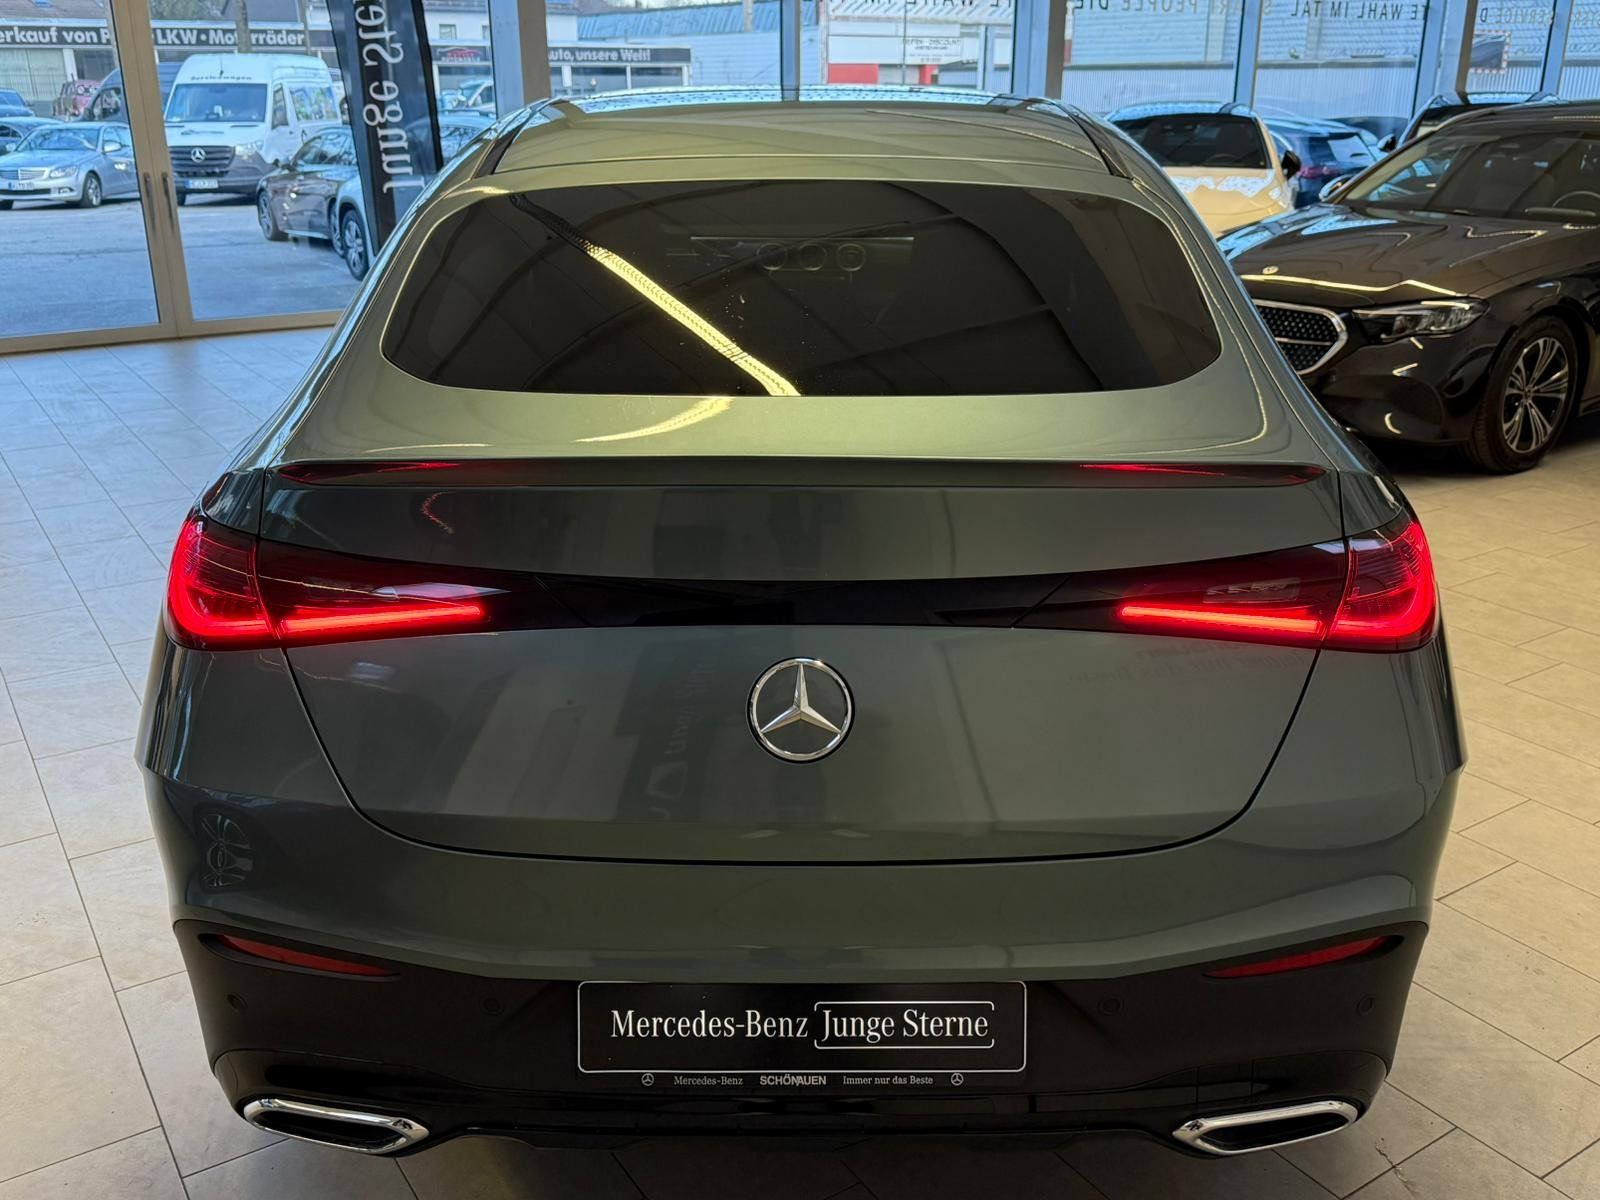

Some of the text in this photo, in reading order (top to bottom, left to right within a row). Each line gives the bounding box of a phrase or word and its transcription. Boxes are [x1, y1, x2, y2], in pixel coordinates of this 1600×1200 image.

[62, 30, 98, 43] von
[156, 29, 197, 45] LKW
[575, 49, 619, 61] unsere
[620, 48, 651, 61] Welt!
[610, 1008, 988, 1044] Mercedes-Benz Junge Sterne
[673, 1075, 744, 1086] Mercedes-Benz
[842, 1075, 872, 1085] Immer
[874, 1077, 890, 1085] nur
[892, 1074, 907, 1085] das
[909, 1075, 933, 1085] Beste
